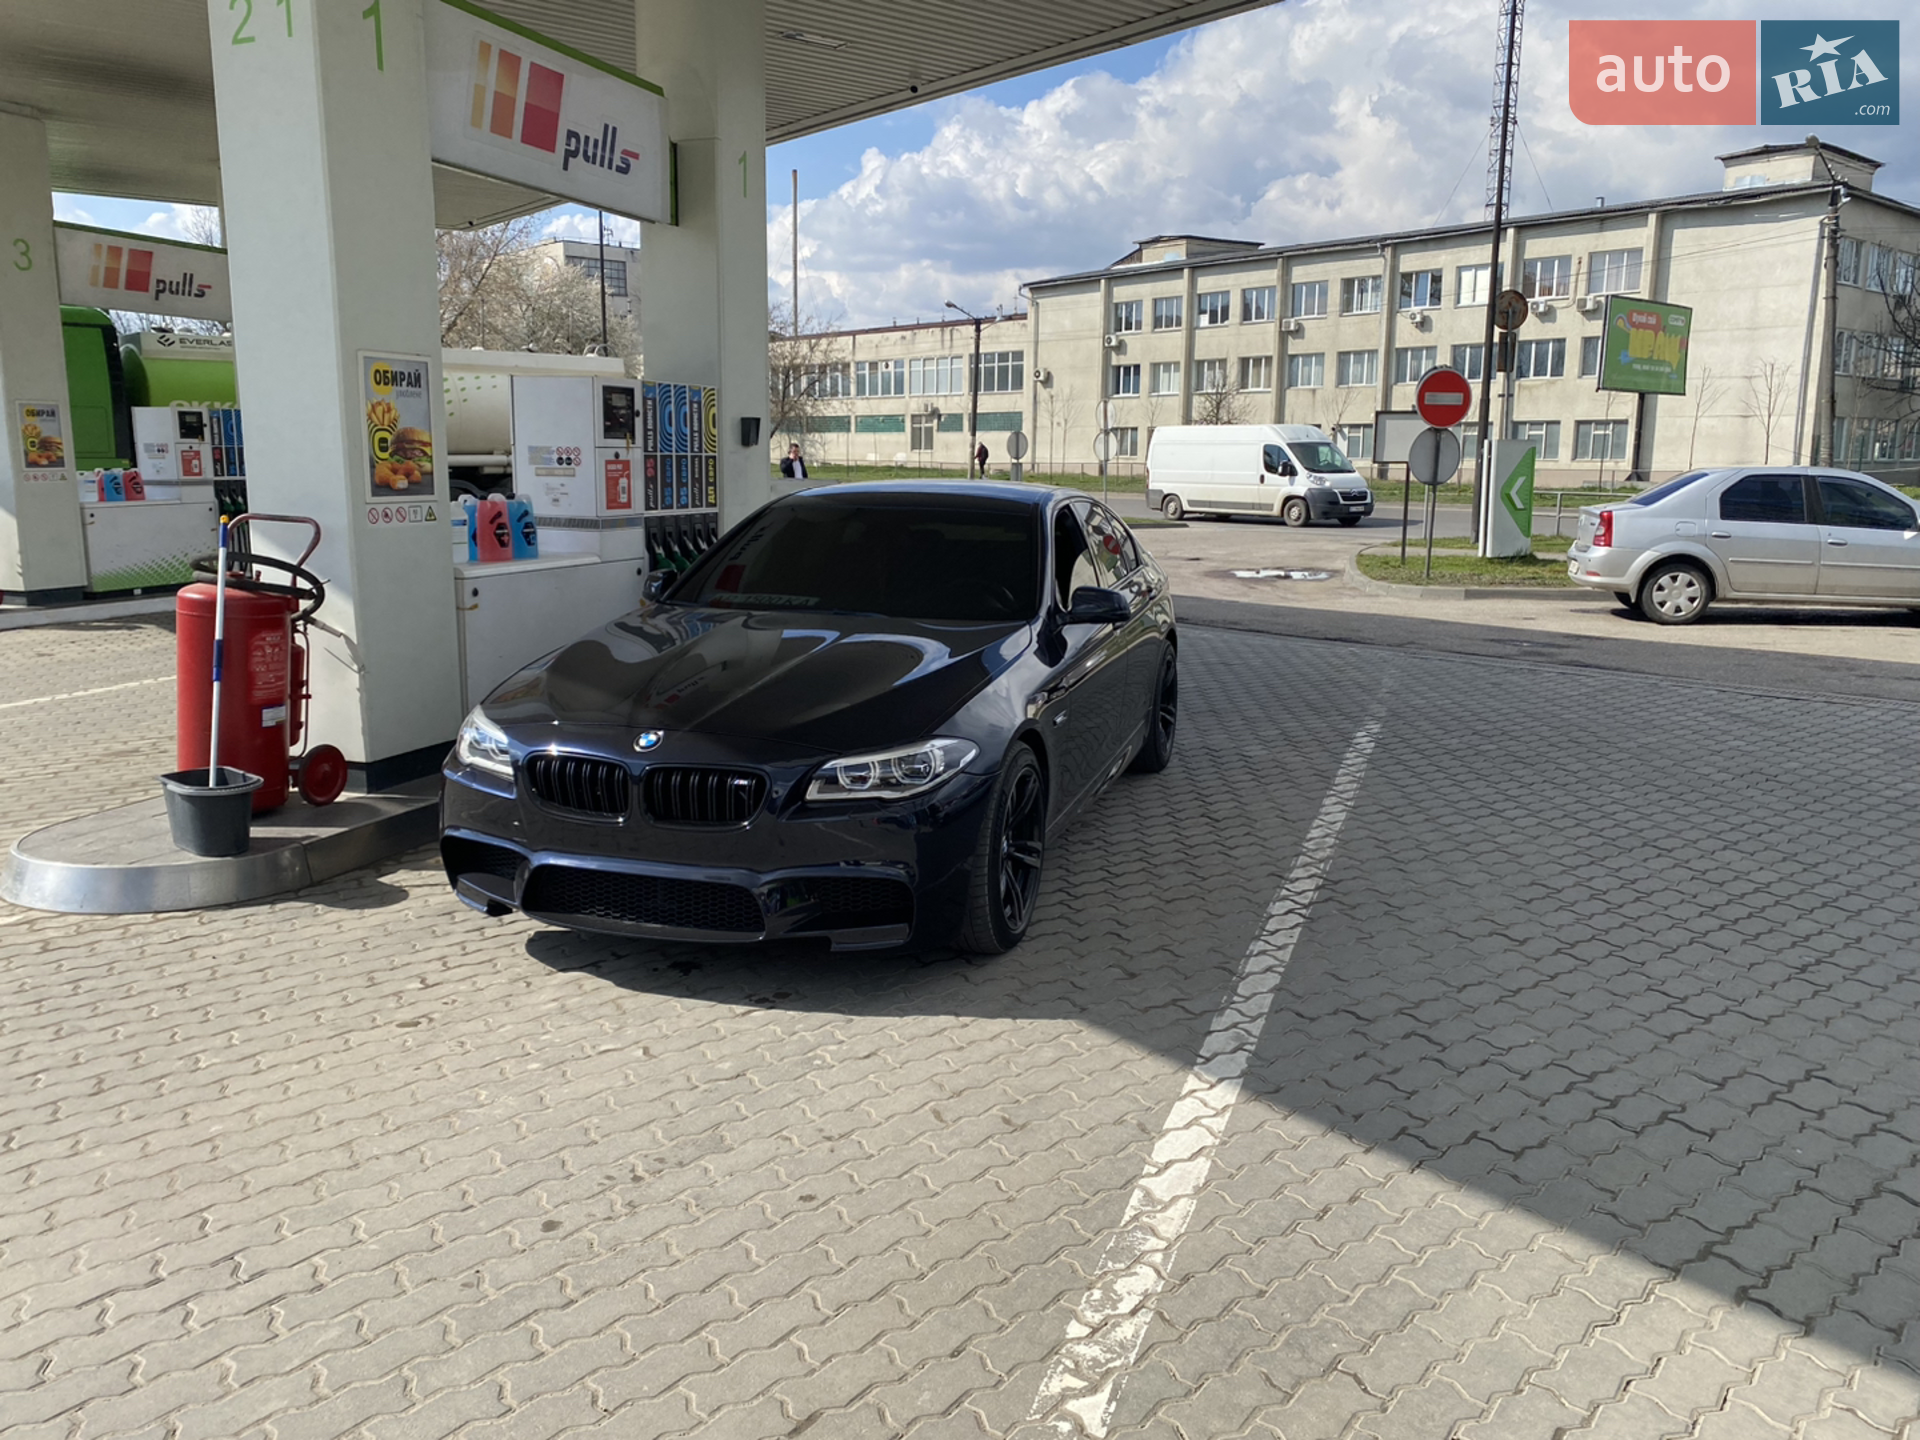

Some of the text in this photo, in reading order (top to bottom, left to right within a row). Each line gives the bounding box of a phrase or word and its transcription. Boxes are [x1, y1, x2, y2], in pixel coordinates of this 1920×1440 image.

[229, 0, 255, 46] 2
[362, 0, 384, 72] 1
[562, 122, 640, 176] pulls
[738, 150, 748, 199] 1
[13, 238, 33, 272] 3
[154, 272, 212, 301] pulls
[373, 368, 422, 389] ОБИРАЙ
[25, 408, 56, 418] ОБИРАЙ
[646, 458, 655, 508] pulls 95
[665, 487, 672, 505] 95
[680, 487, 688, 505] 95
[708, 487, 715, 504] ДП
